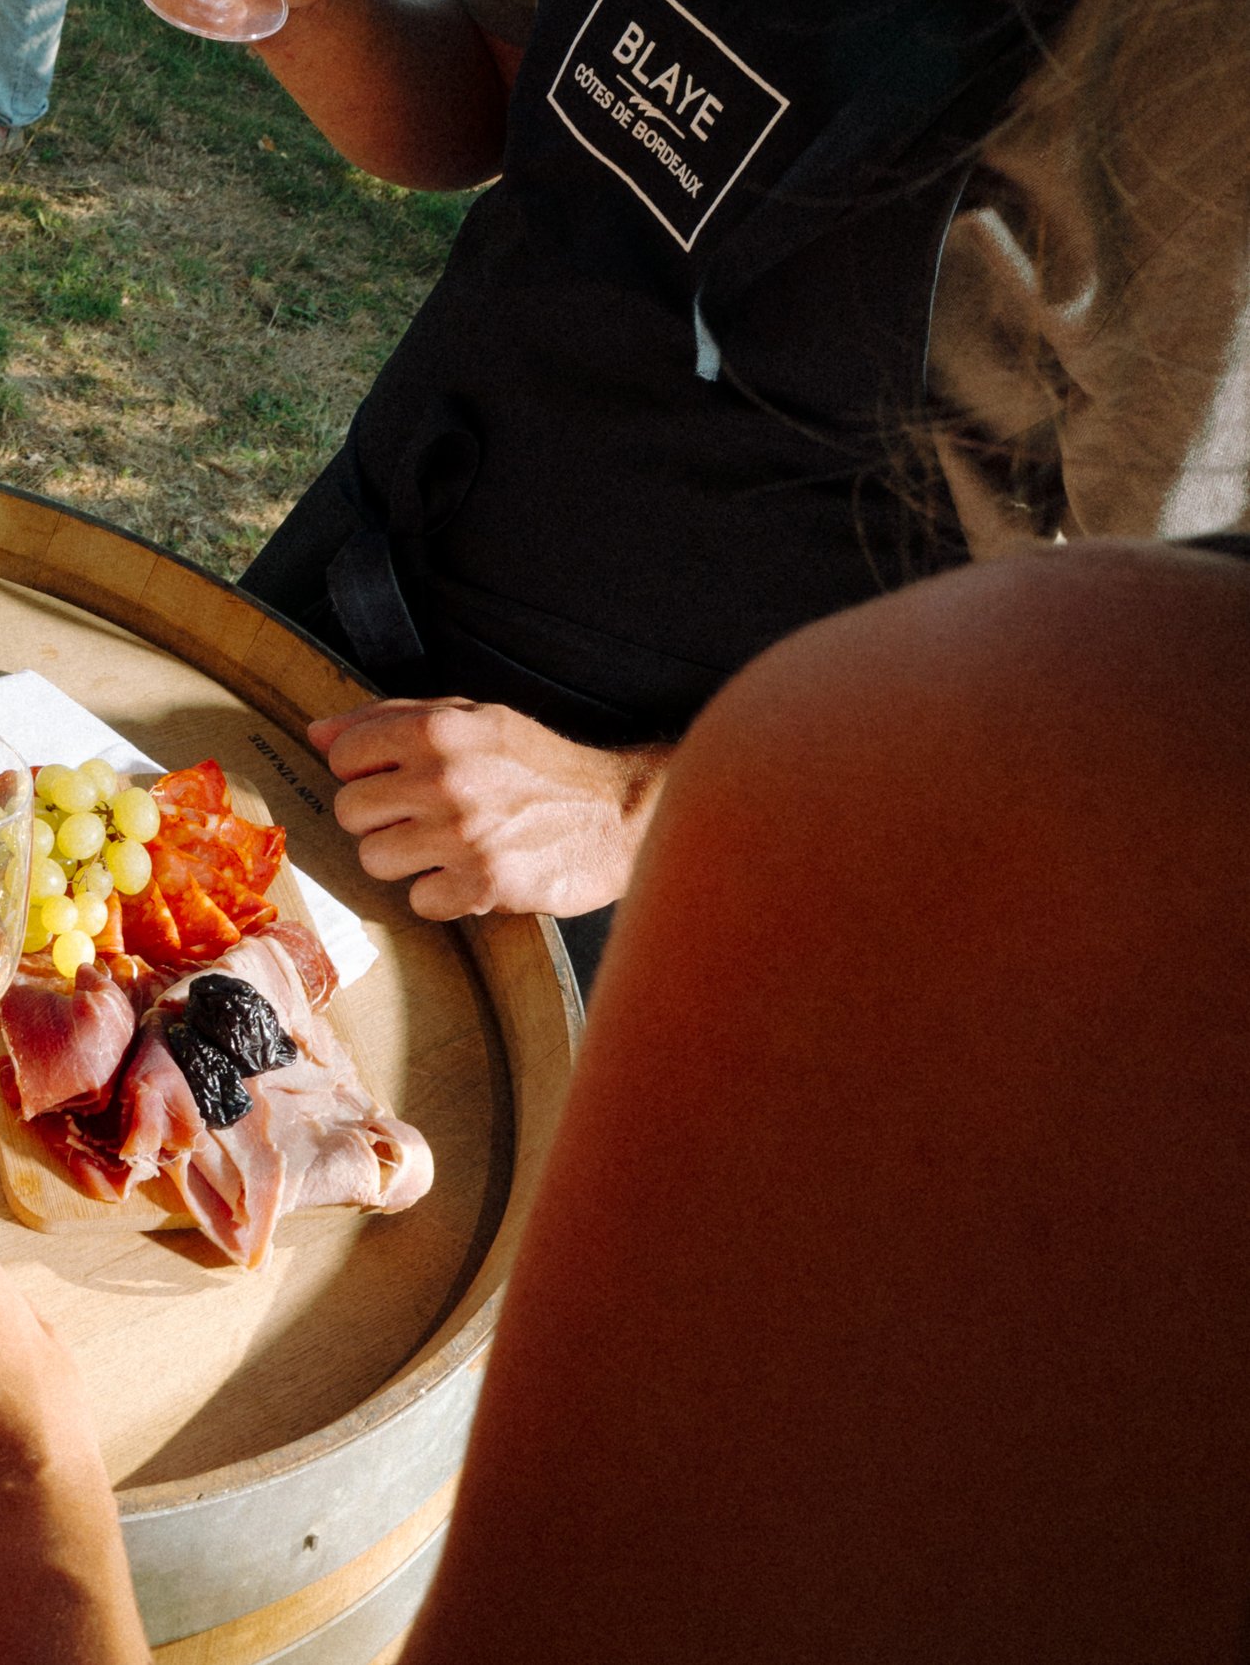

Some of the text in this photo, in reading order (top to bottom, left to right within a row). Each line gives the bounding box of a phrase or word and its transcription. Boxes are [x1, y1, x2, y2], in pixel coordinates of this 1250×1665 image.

[574, 63, 704, 199] CÔTES DE BORDEAUX
[612, 21, 724, 142] BLAYE
[295, 786, 329, 815] NON
